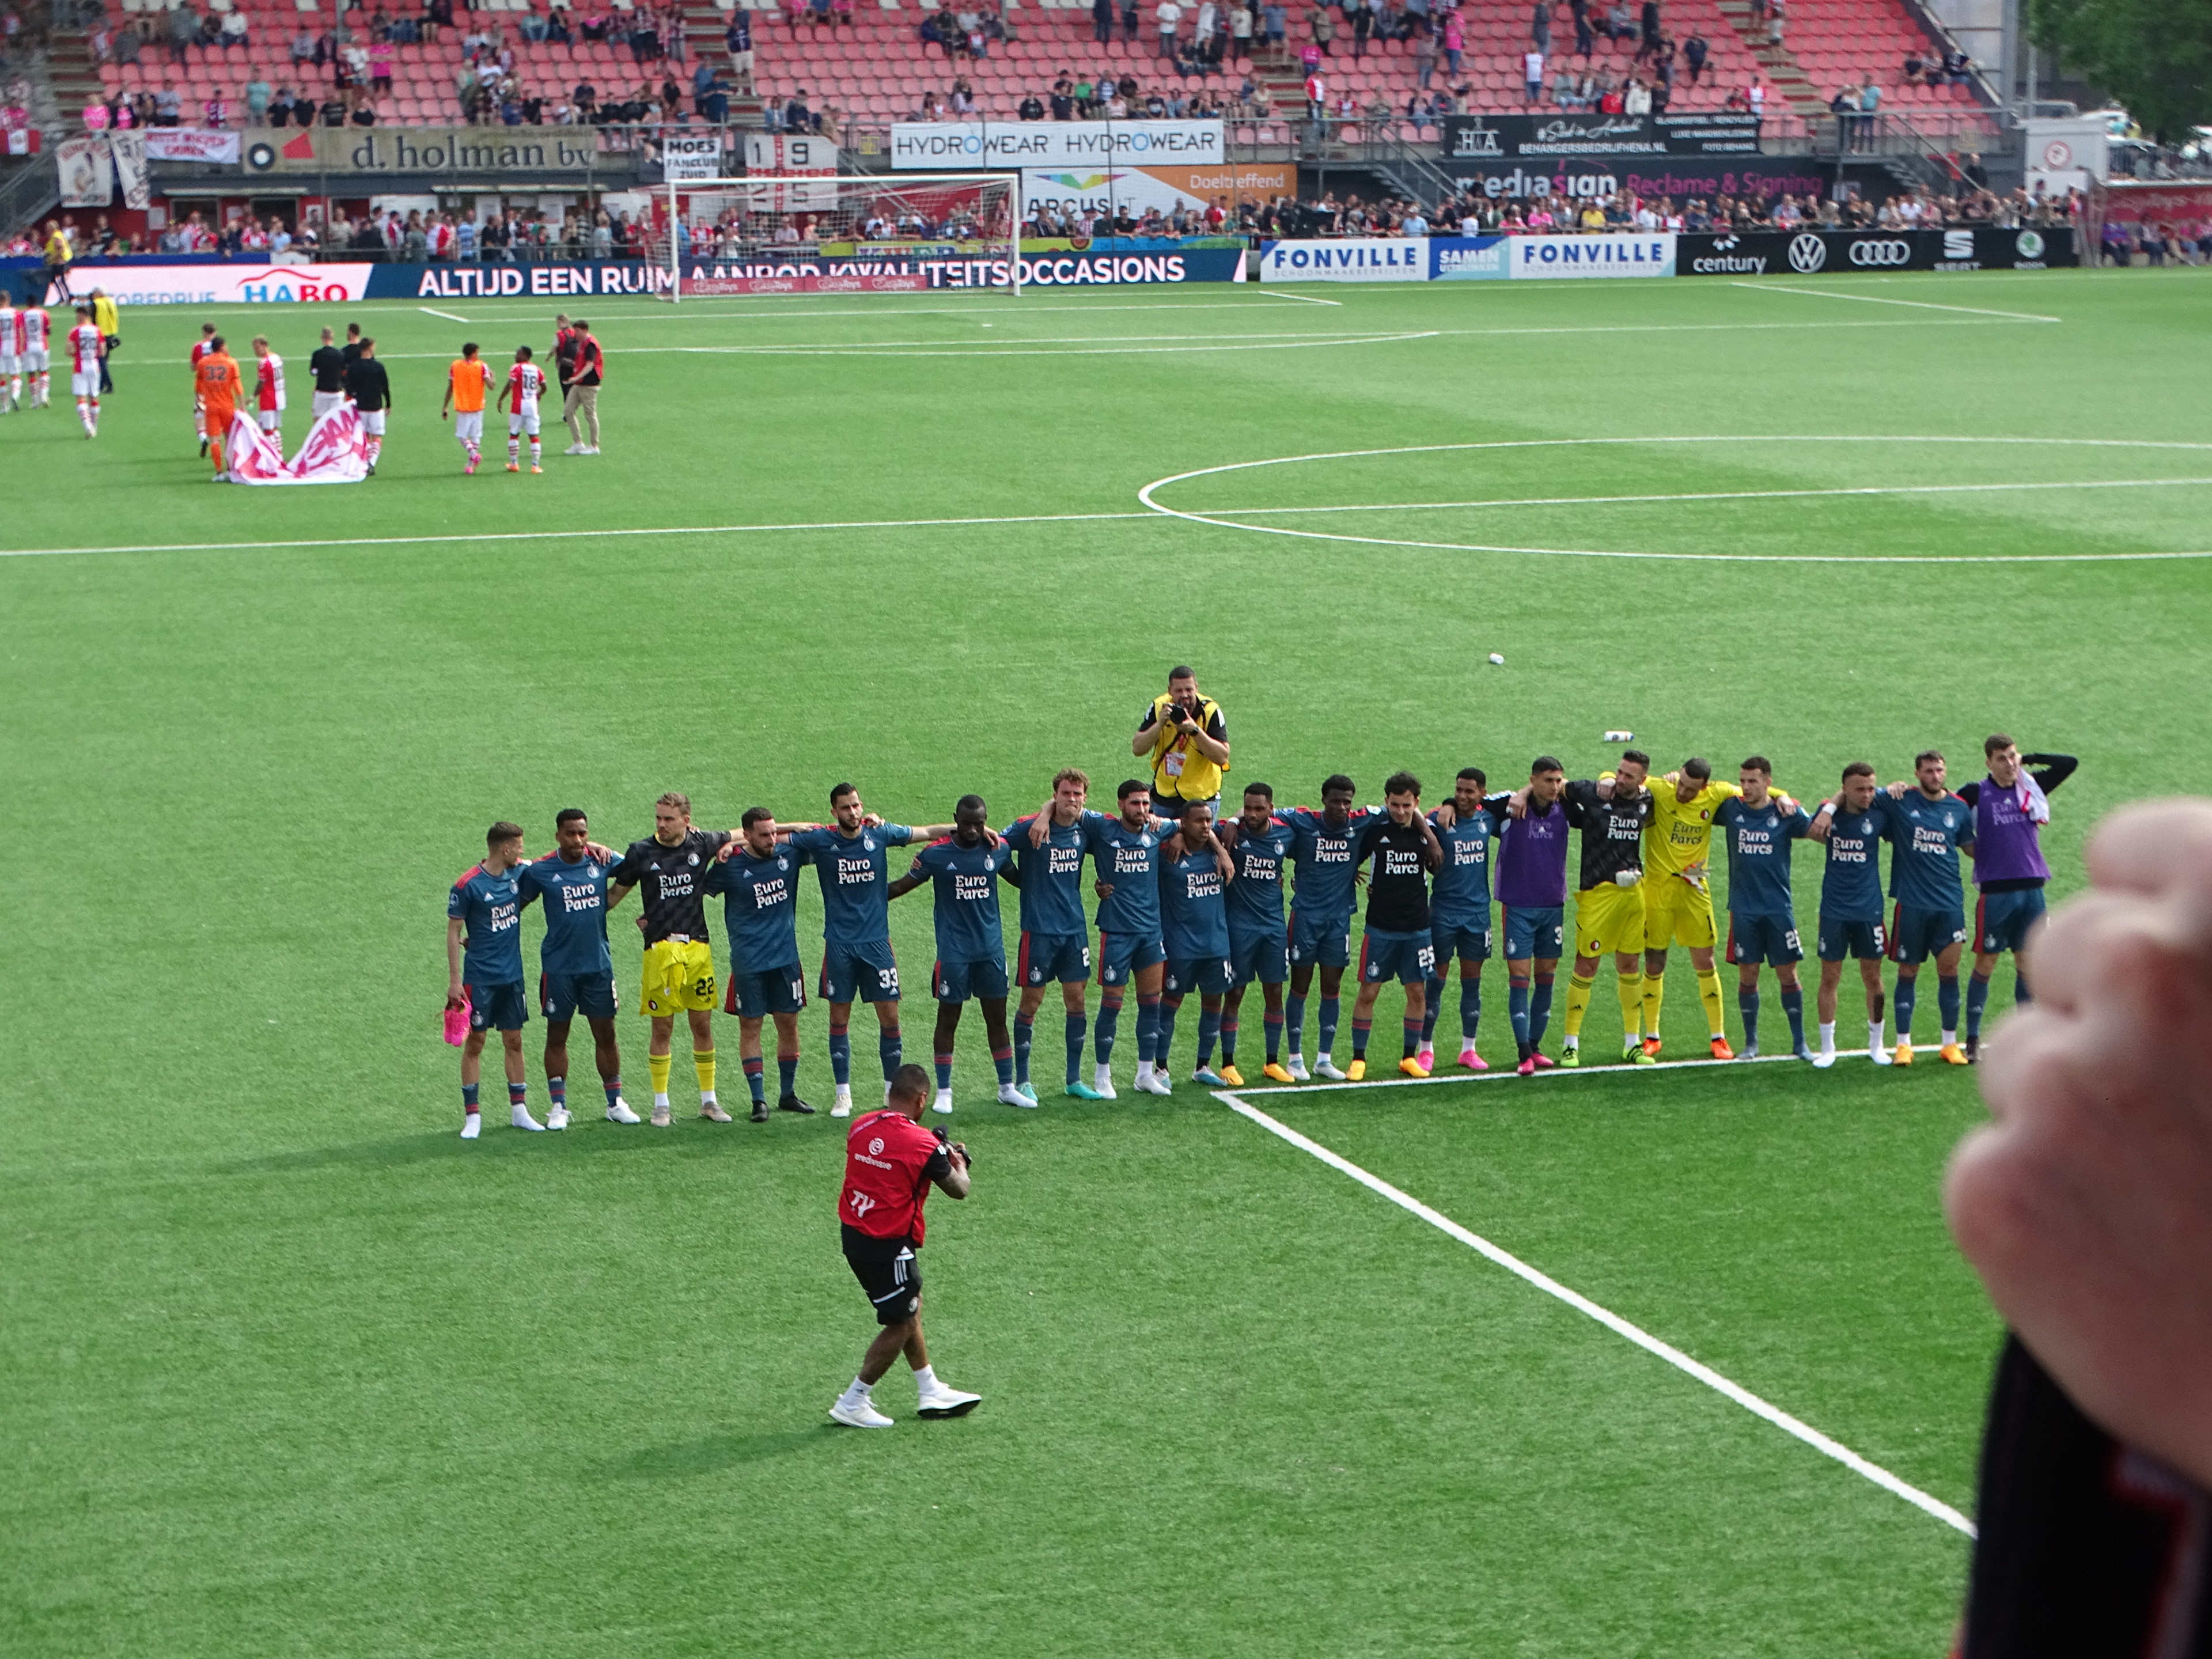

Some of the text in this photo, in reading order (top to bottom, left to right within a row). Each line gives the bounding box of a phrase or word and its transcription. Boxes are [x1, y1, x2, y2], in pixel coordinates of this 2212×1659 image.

[352, 134, 592, 169] d. holman bv
[668, 139, 715, 154] MOES
[897, 132, 1215, 156] HYDROWEAR HYDROWEAR
[1190, 173, 1285, 190] Doeltreffend
[1627, 173, 1718, 195] Reclame
[1721, 173, 1738, 194] &
[1743, 171, 1823, 198] Signing
[1027, 197, 1109, 215] ARCUS
[1274, 247, 1416, 268] FONVILLE
[1439, 249, 1499, 264] SAMEN
[1524, 243, 1663, 264] FONVILLE
[1693, 255, 1767, 274] century
[419, 268, 525, 297] ALTIJD
[531, 268, 593, 295] EEN
[601, 265, 680, 294] RUIM
[244, 284, 349, 302] HABO
[205, 365, 228, 381] 32
[522, 373, 537, 391] 18
[1609, 815, 1639, 830] Euro
[1672, 821, 1703, 835] Euro
[1607, 828, 1639, 842] Parcs
[1670, 833, 1703, 846] Parcs
[1738, 828, 1770, 843] Euro
[1914, 826, 1946, 843] Euro
[1316, 837, 1348, 851] Euro
[1453, 840, 1484, 854] Euro
[1737, 842, 1774, 855] Parcs
[1832, 836, 1864, 851] Euro
[1912, 839, 1948, 855] Parcs
[1050, 847, 1078, 861] Euro
[1115, 847, 1146, 861] Euro
[1245, 854, 1276, 870] Euro
[1315, 849, 1351, 863] Parcs
[1385, 850, 1418, 863] Euro
[1454, 853, 1486, 866] Parcs
[1831, 849, 1867, 864] Parcs
[838, 858, 870, 872] Euro
[1048, 860, 1080, 874] Parcs
[1114, 859, 1149, 874] Parcs
[1243, 866, 1277, 880] Parcs
[1385, 862, 1419, 874] Parcs
[658, 872, 692, 888] Euro
[838, 869, 876, 885] Parcs
[955, 874, 988, 888] Euro
[1186, 872, 1218, 887] Euro
[562, 883, 596, 900] Euro
[659, 883, 694, 900] Parcs
[752, 878, 785, 897] Euro
[955, 887, 990, 900] Parcs
[1187, 883, 1221, 899] Parcs
[564, 896, 600, 912] Parcs
[755, 888, 788, 909] Parcs
[490, 902, 516, 919] Euro
[1873, 926, 1884, 945] 5
[1418, 945, 1435, 968] 25
[878, 966, 900, 989] 33
[695, 976, 714, 997] 22
